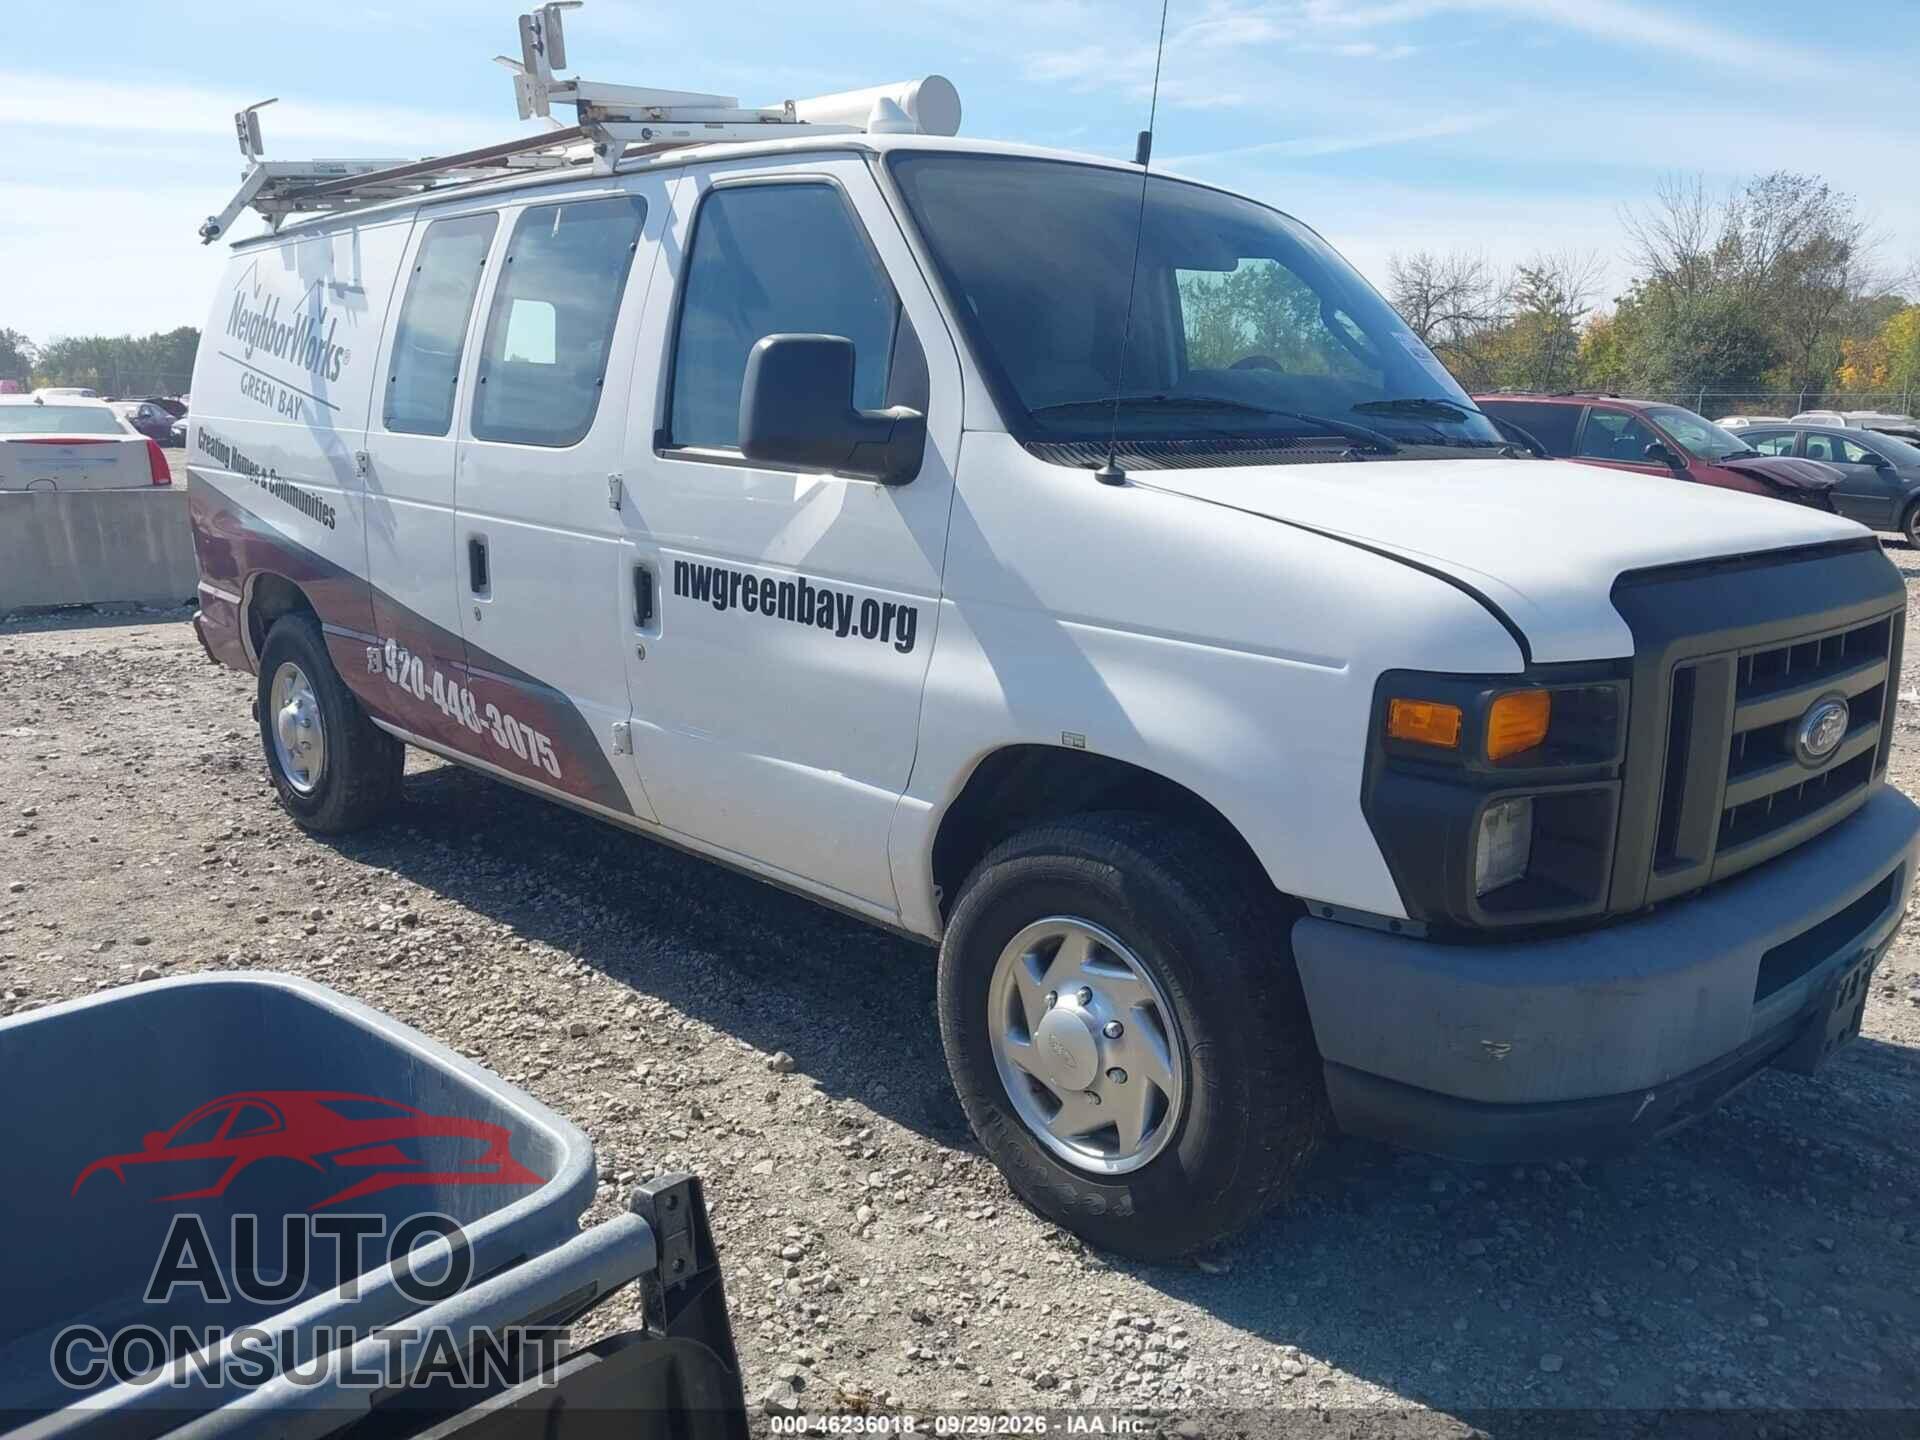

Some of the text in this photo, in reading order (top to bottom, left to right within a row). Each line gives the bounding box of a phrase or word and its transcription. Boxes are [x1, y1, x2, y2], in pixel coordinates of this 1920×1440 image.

[240, 371, 303, 421] GREEN BAY
[198, 427, 336, 530] Creating Homes & Communities
[674, 560, 918, 654] nwgreenbay.org
[384, 638, 562, 779] 920-448-3075
